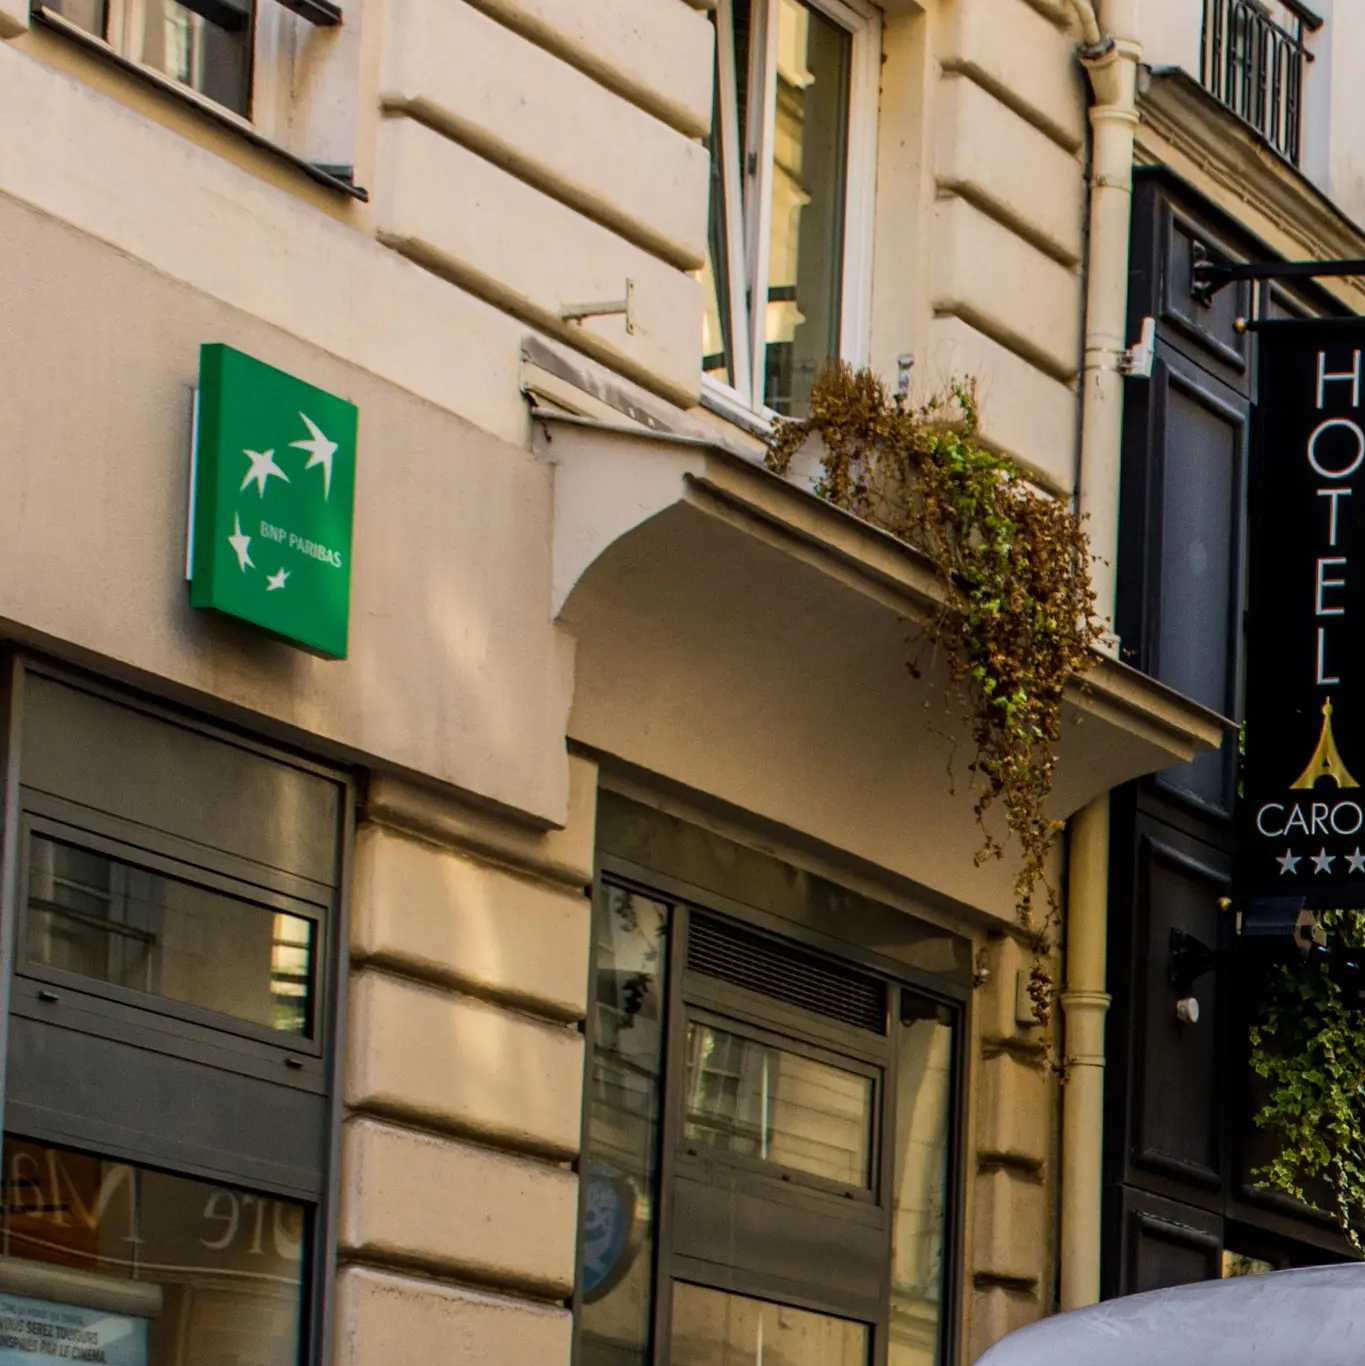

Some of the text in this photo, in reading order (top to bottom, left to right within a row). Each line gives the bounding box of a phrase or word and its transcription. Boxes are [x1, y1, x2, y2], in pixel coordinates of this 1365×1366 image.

[260, 520, 342, 568] BNP PARIBAS
[1307, 349, 1365, 685] HOTEL
